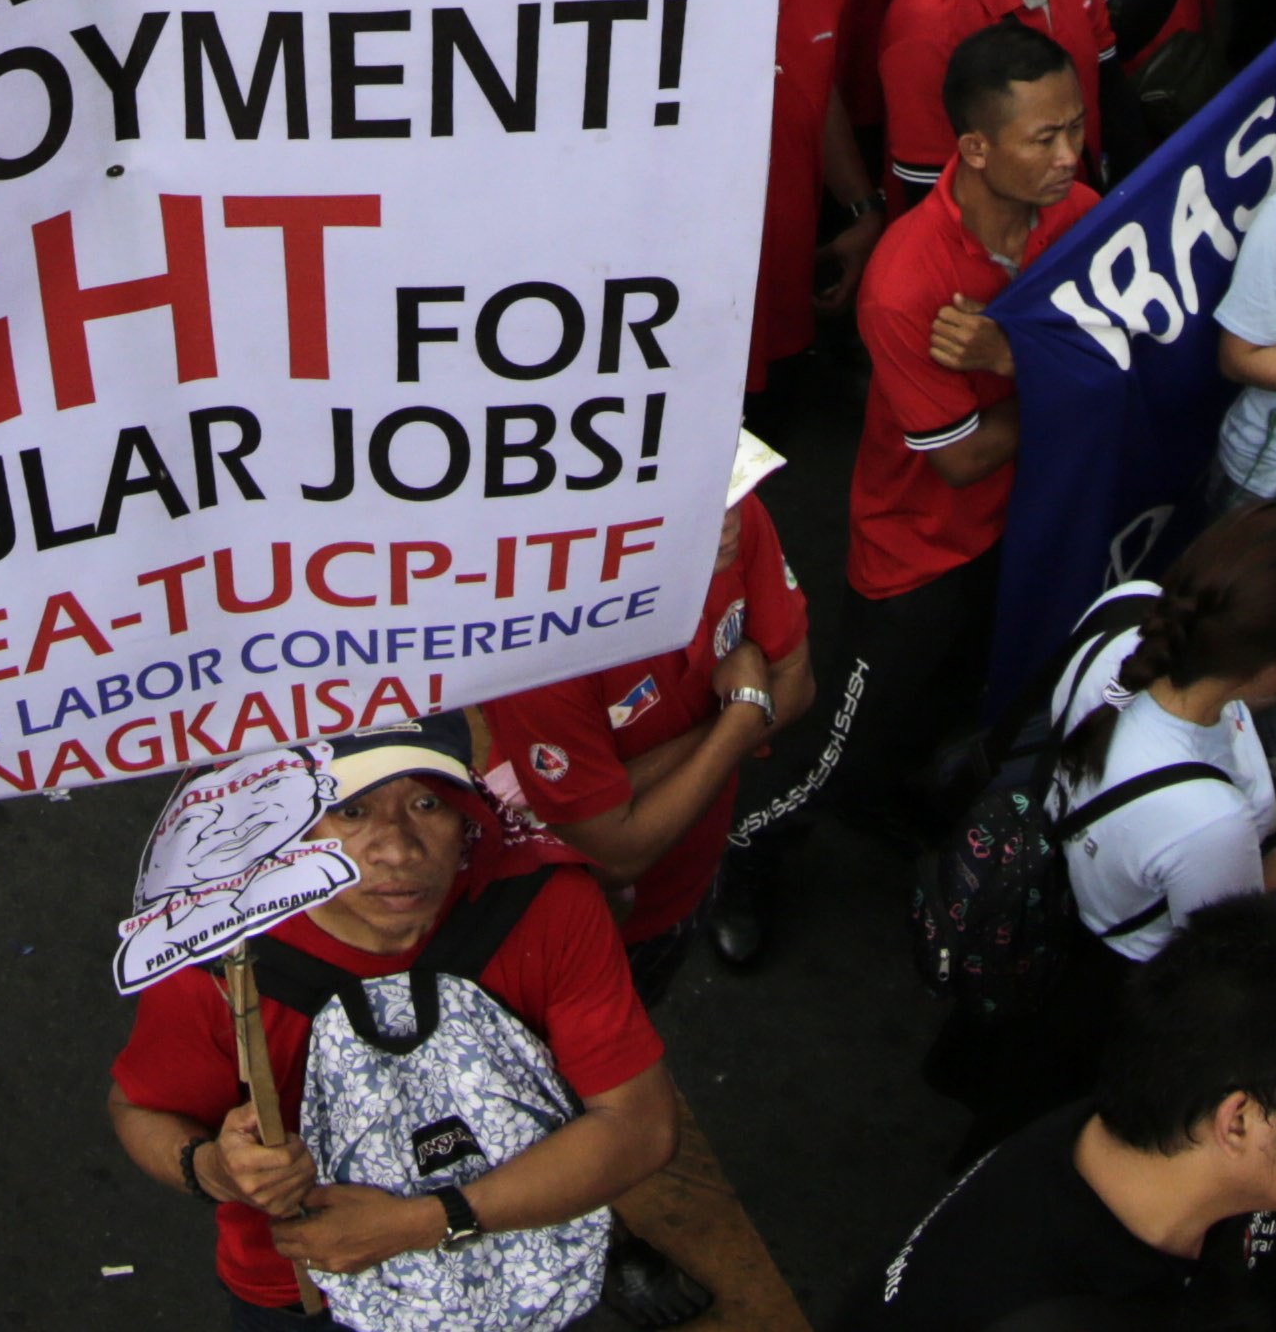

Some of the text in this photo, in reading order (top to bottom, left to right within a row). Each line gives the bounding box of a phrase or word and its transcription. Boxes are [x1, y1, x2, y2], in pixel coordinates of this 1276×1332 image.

[396, 275, 681, 382] FOR
[302, 392, 665, 504] JOBS!
[14, 647, 227, 732] LABOR
[238, 588, 656, 676] CONFERENCE
[212, 886, 330, 936] MANGGAGAWA
